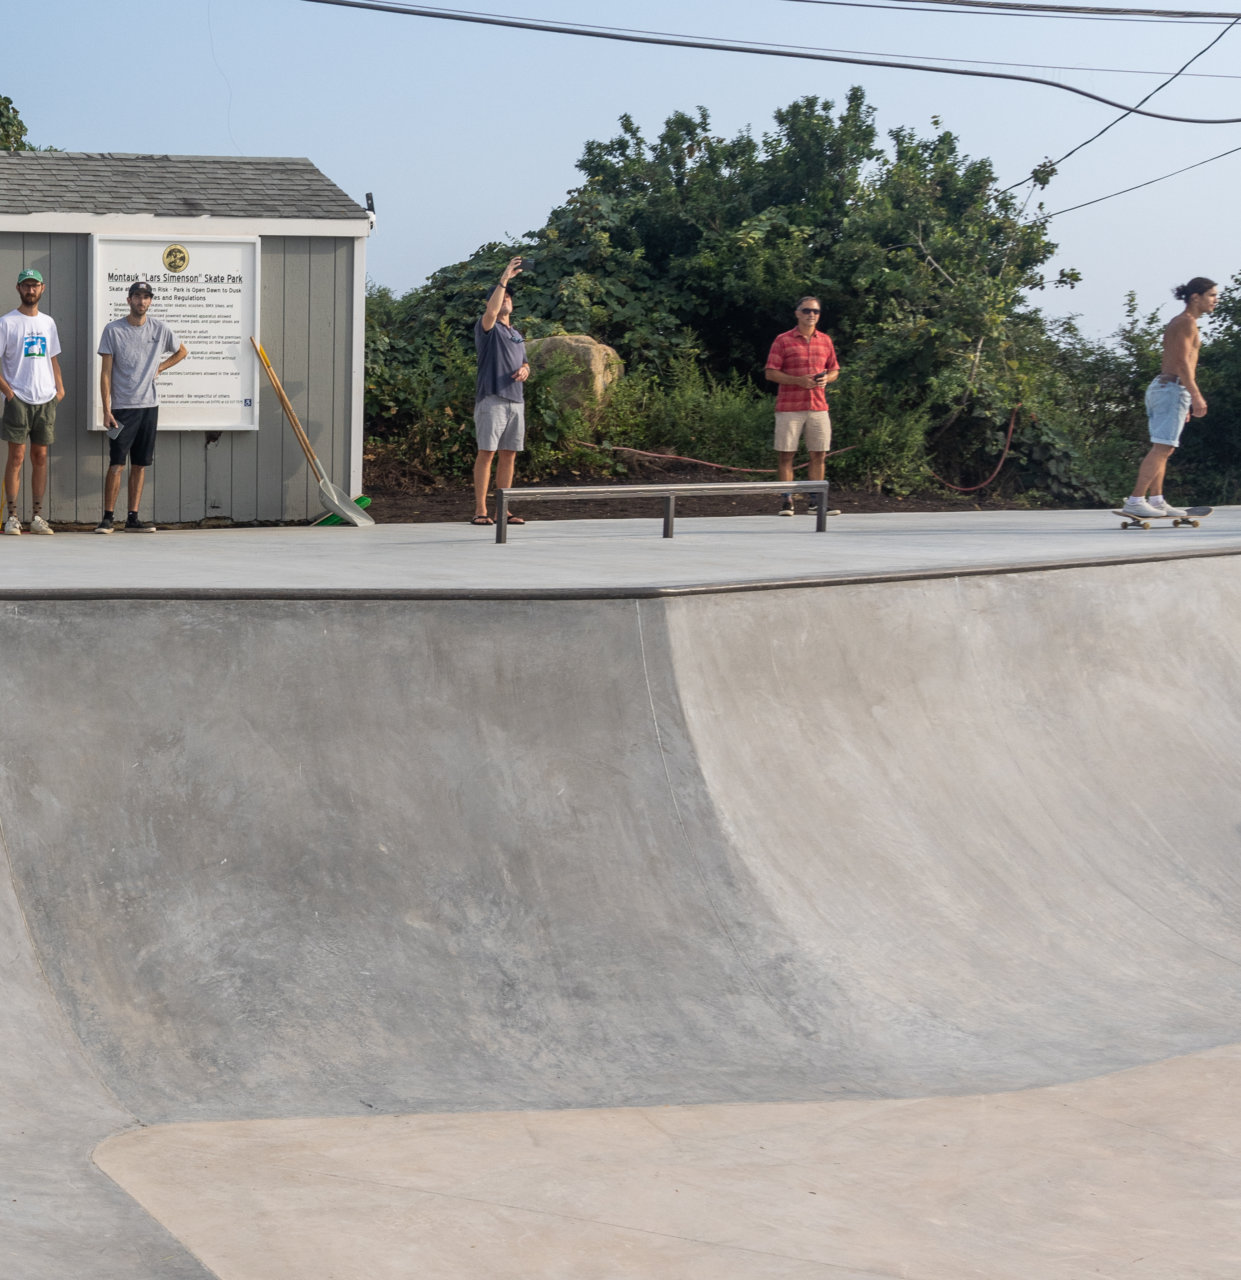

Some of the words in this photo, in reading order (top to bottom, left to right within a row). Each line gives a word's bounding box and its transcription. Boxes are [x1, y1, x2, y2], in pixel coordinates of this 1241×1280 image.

[108, 272, 139, 282] Montauk
[142, 273, 160, 282] "Lars
[163, 273, 202, 282] Simenson"
[204, 274, 224, 283] Skate
[227, 274, 242, 283] Park
